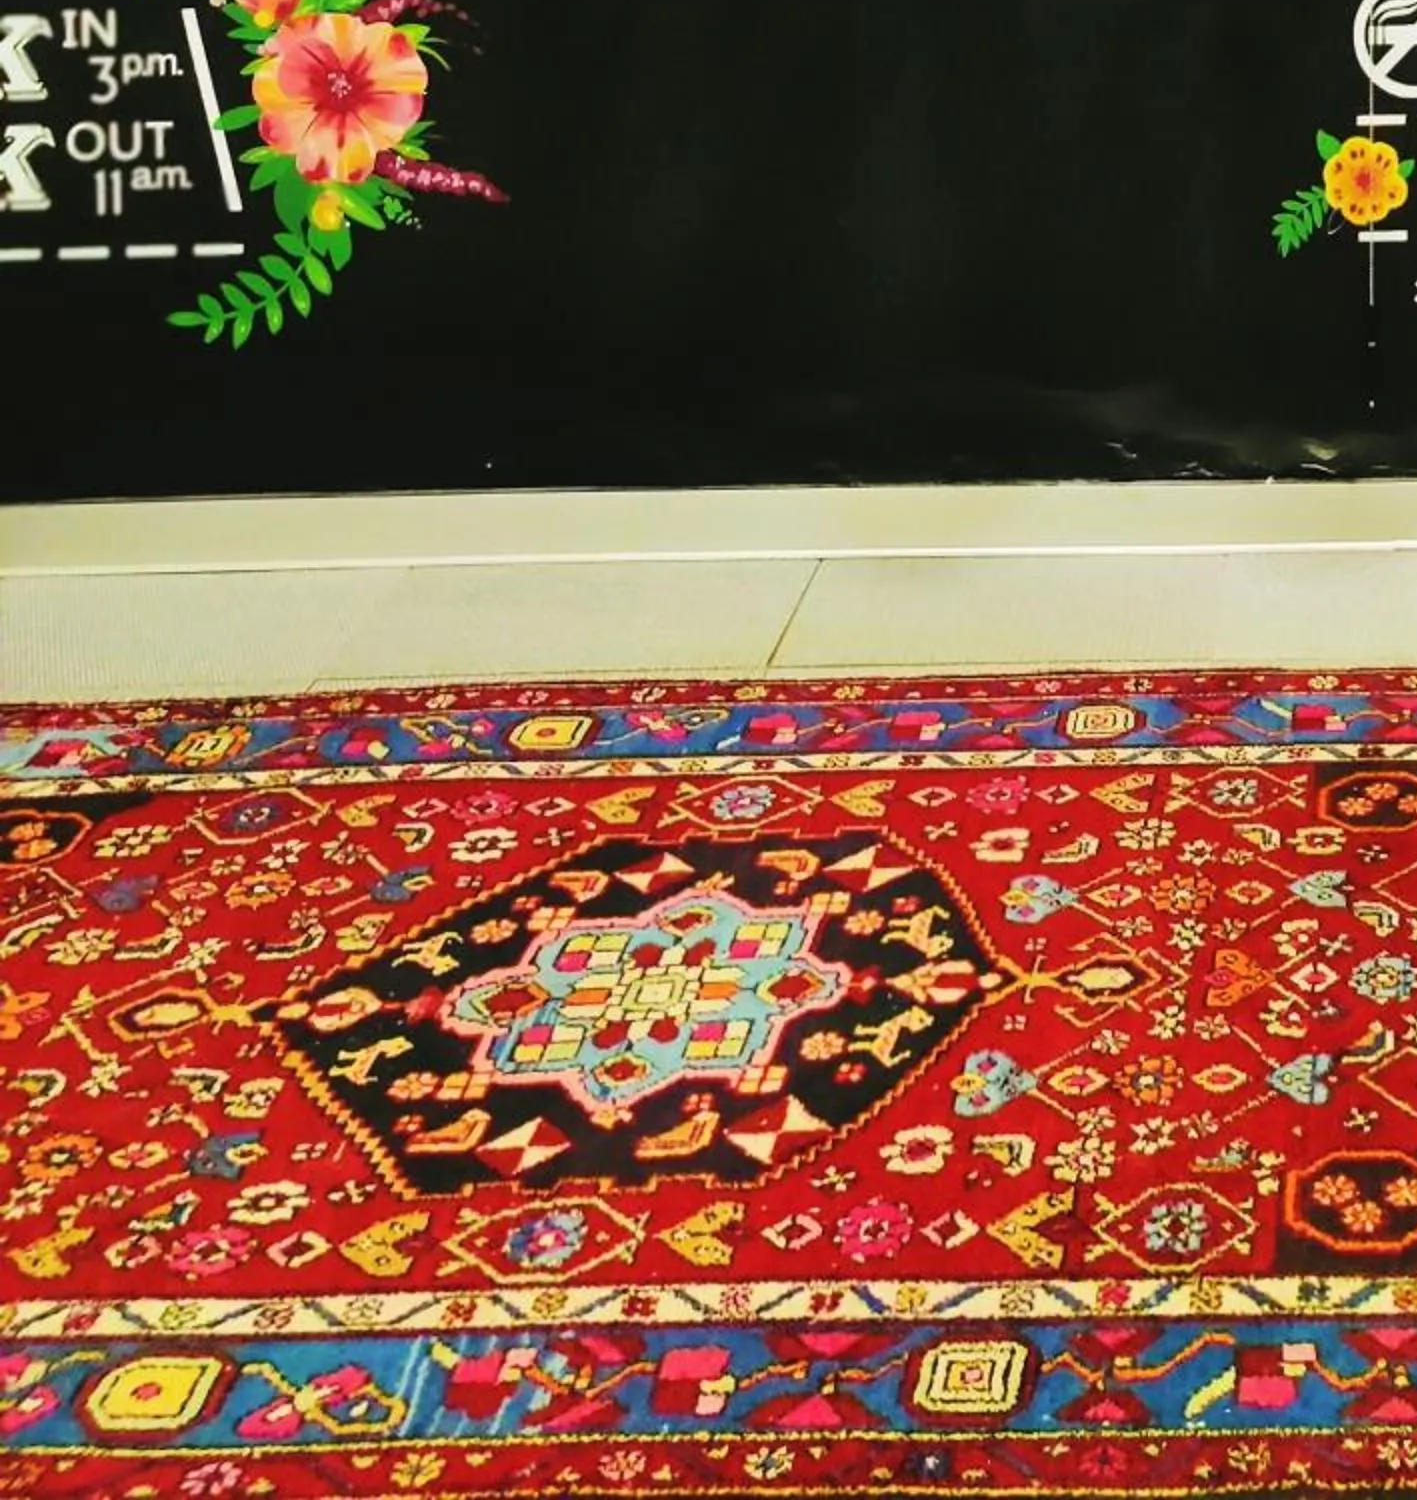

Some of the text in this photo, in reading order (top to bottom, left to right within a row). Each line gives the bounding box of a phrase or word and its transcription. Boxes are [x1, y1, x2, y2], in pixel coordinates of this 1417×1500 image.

[62, 9, 117, 49] IN
[89, 55, 119, 104] 3
[66, 120, 174, 162] OUT
[95, 169, 122, 216] 11
